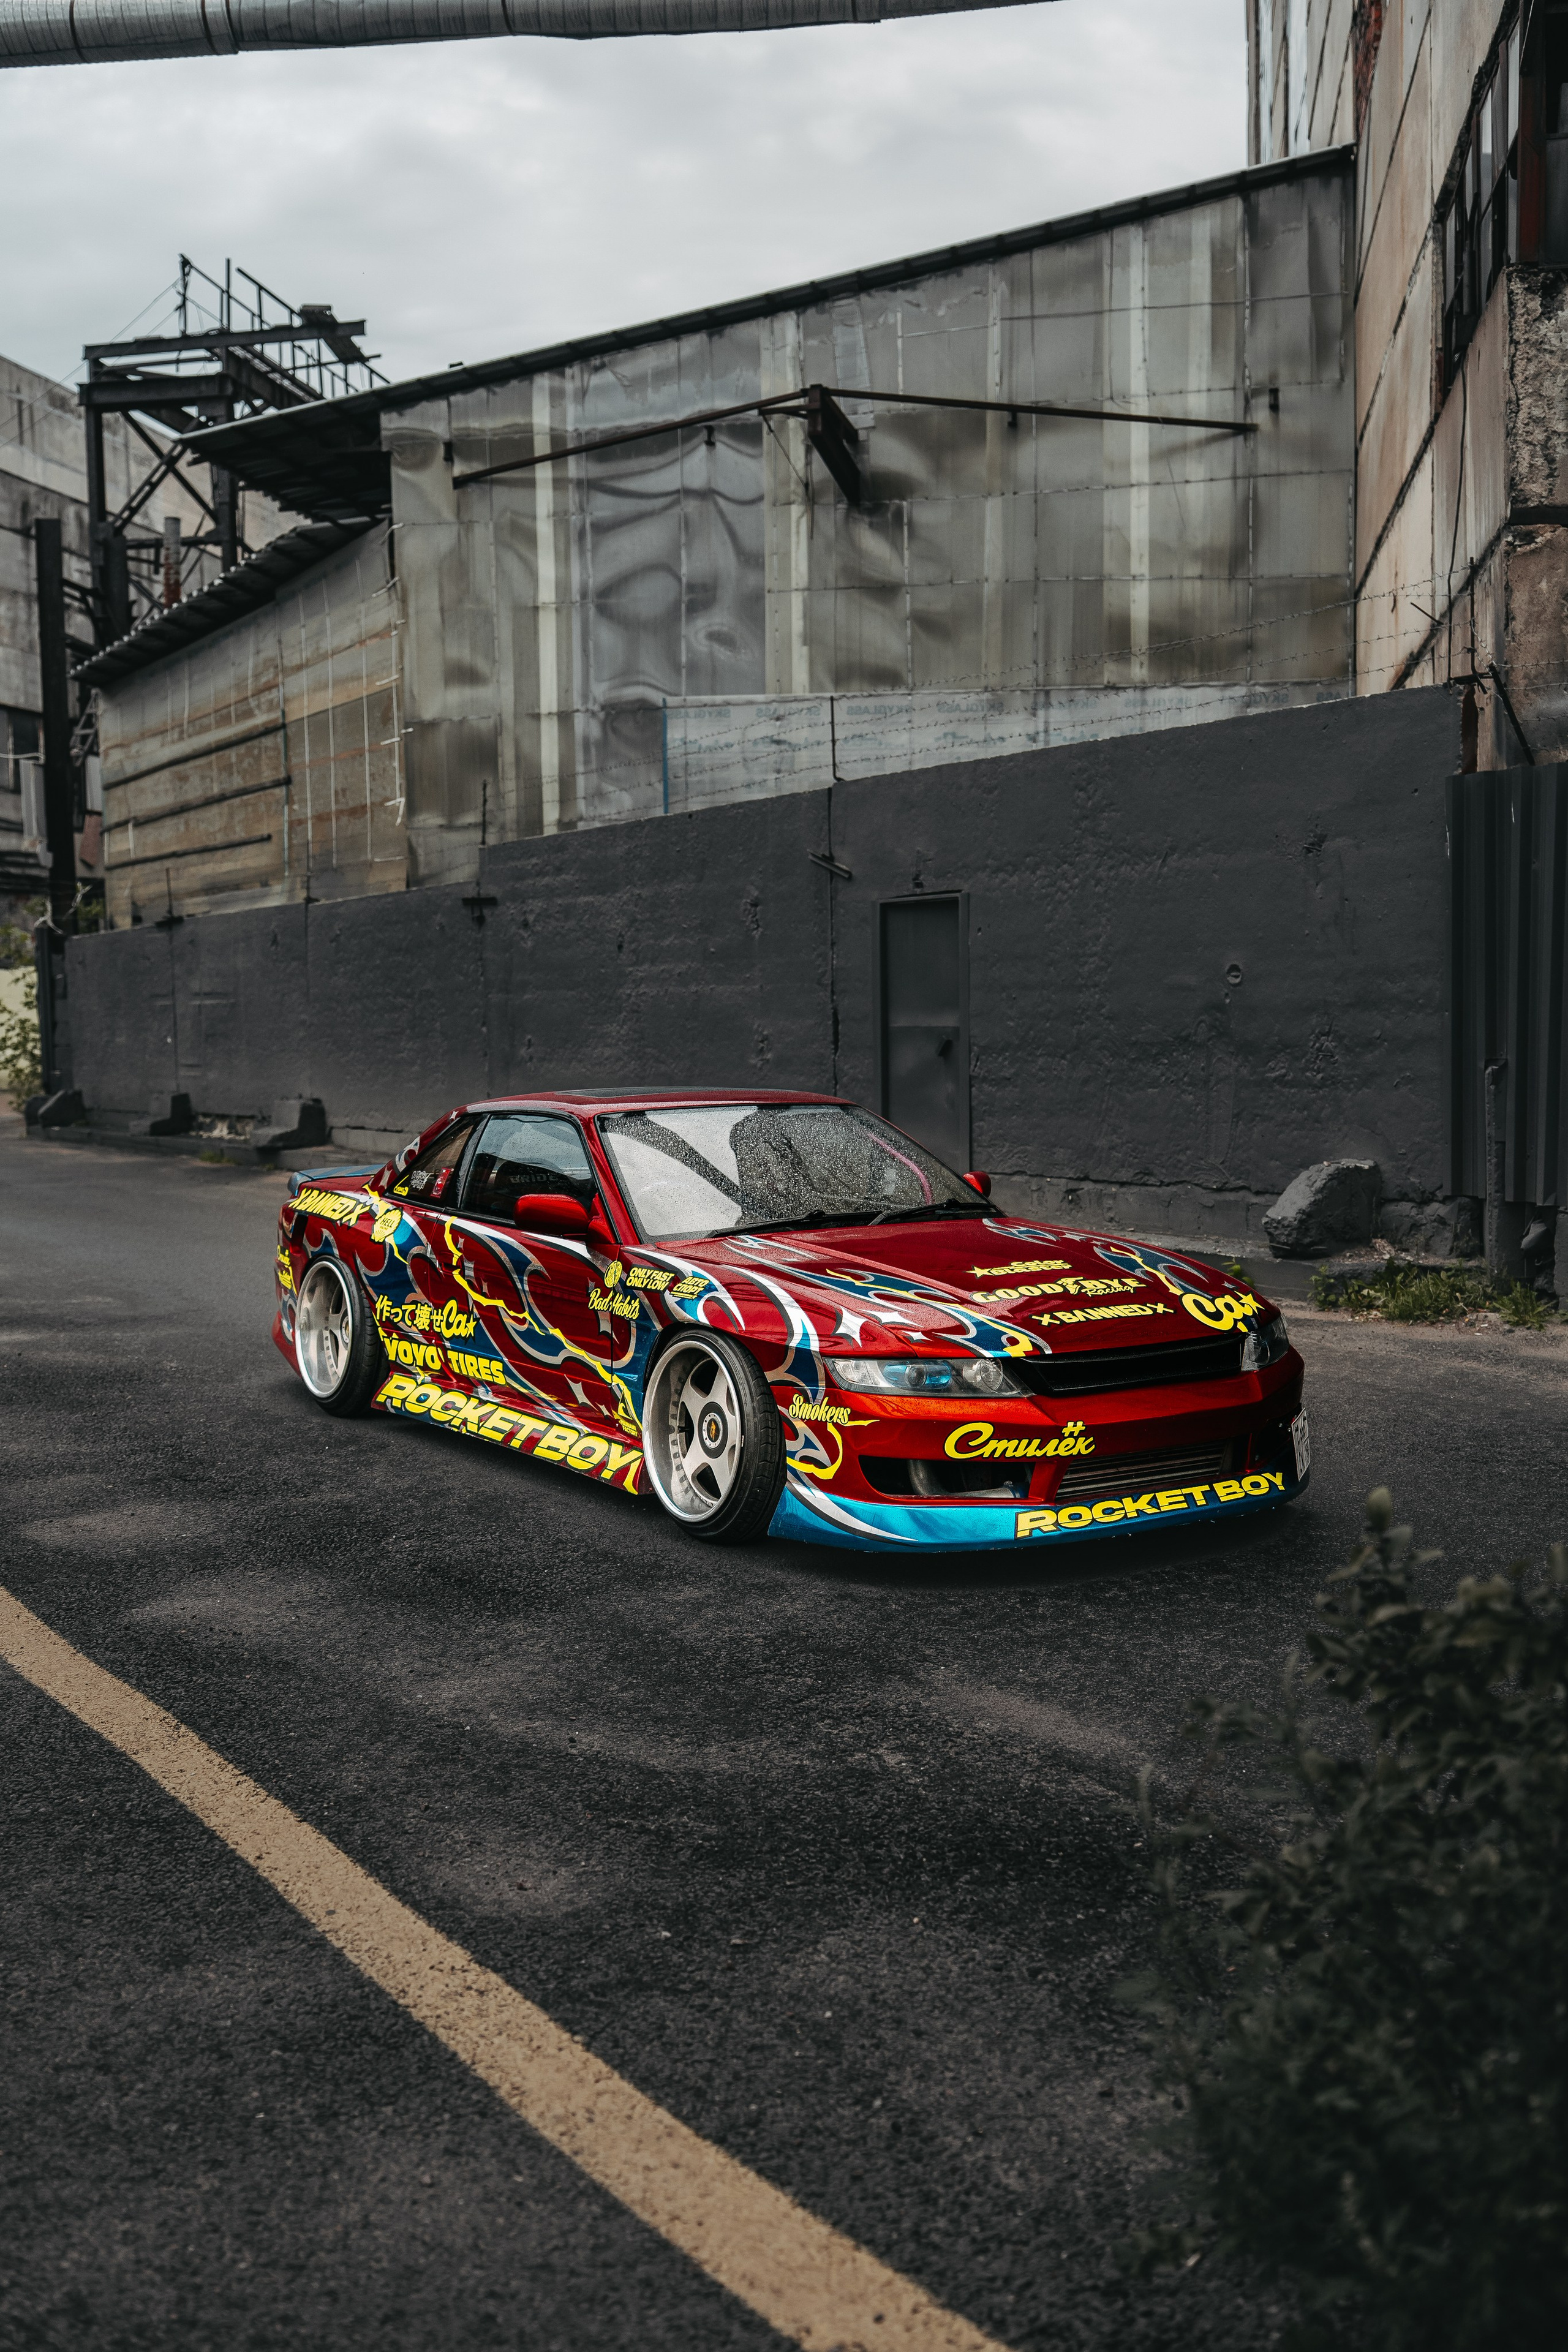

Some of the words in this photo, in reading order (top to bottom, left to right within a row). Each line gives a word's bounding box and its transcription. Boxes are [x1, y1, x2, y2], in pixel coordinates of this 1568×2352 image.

[380, 1217, 395, 1228] HELL
[630, 1267, 652, 1279] ONLY
[650, 1270, 674, 1282] FAST
[990, 1264, 1072, 1276] Blaster
[626, 1276, 649, 1288] ONLY
[647, 1279, 669, 1291] LOW
[673, 1283, 704, 1295] СПОРТ
[681, 1276, 710, 1287] АВТО
[972, 1283, 1065, 1303] GOOD
[1079, 1278, 1147, 1290] BYE
[1080, 1286, 1134, 1297] Racing
[588, 1287, 613, 1311] Bad
[609, 1292, 640, 1320] Habits
[375, 1294, 443, 1333] 作って壊せ
[383, 1337, 445, 1371] YOYO
[447, 1349, 507, 1385] TIRES
[788, 1393, 851, 1424] Smokers
